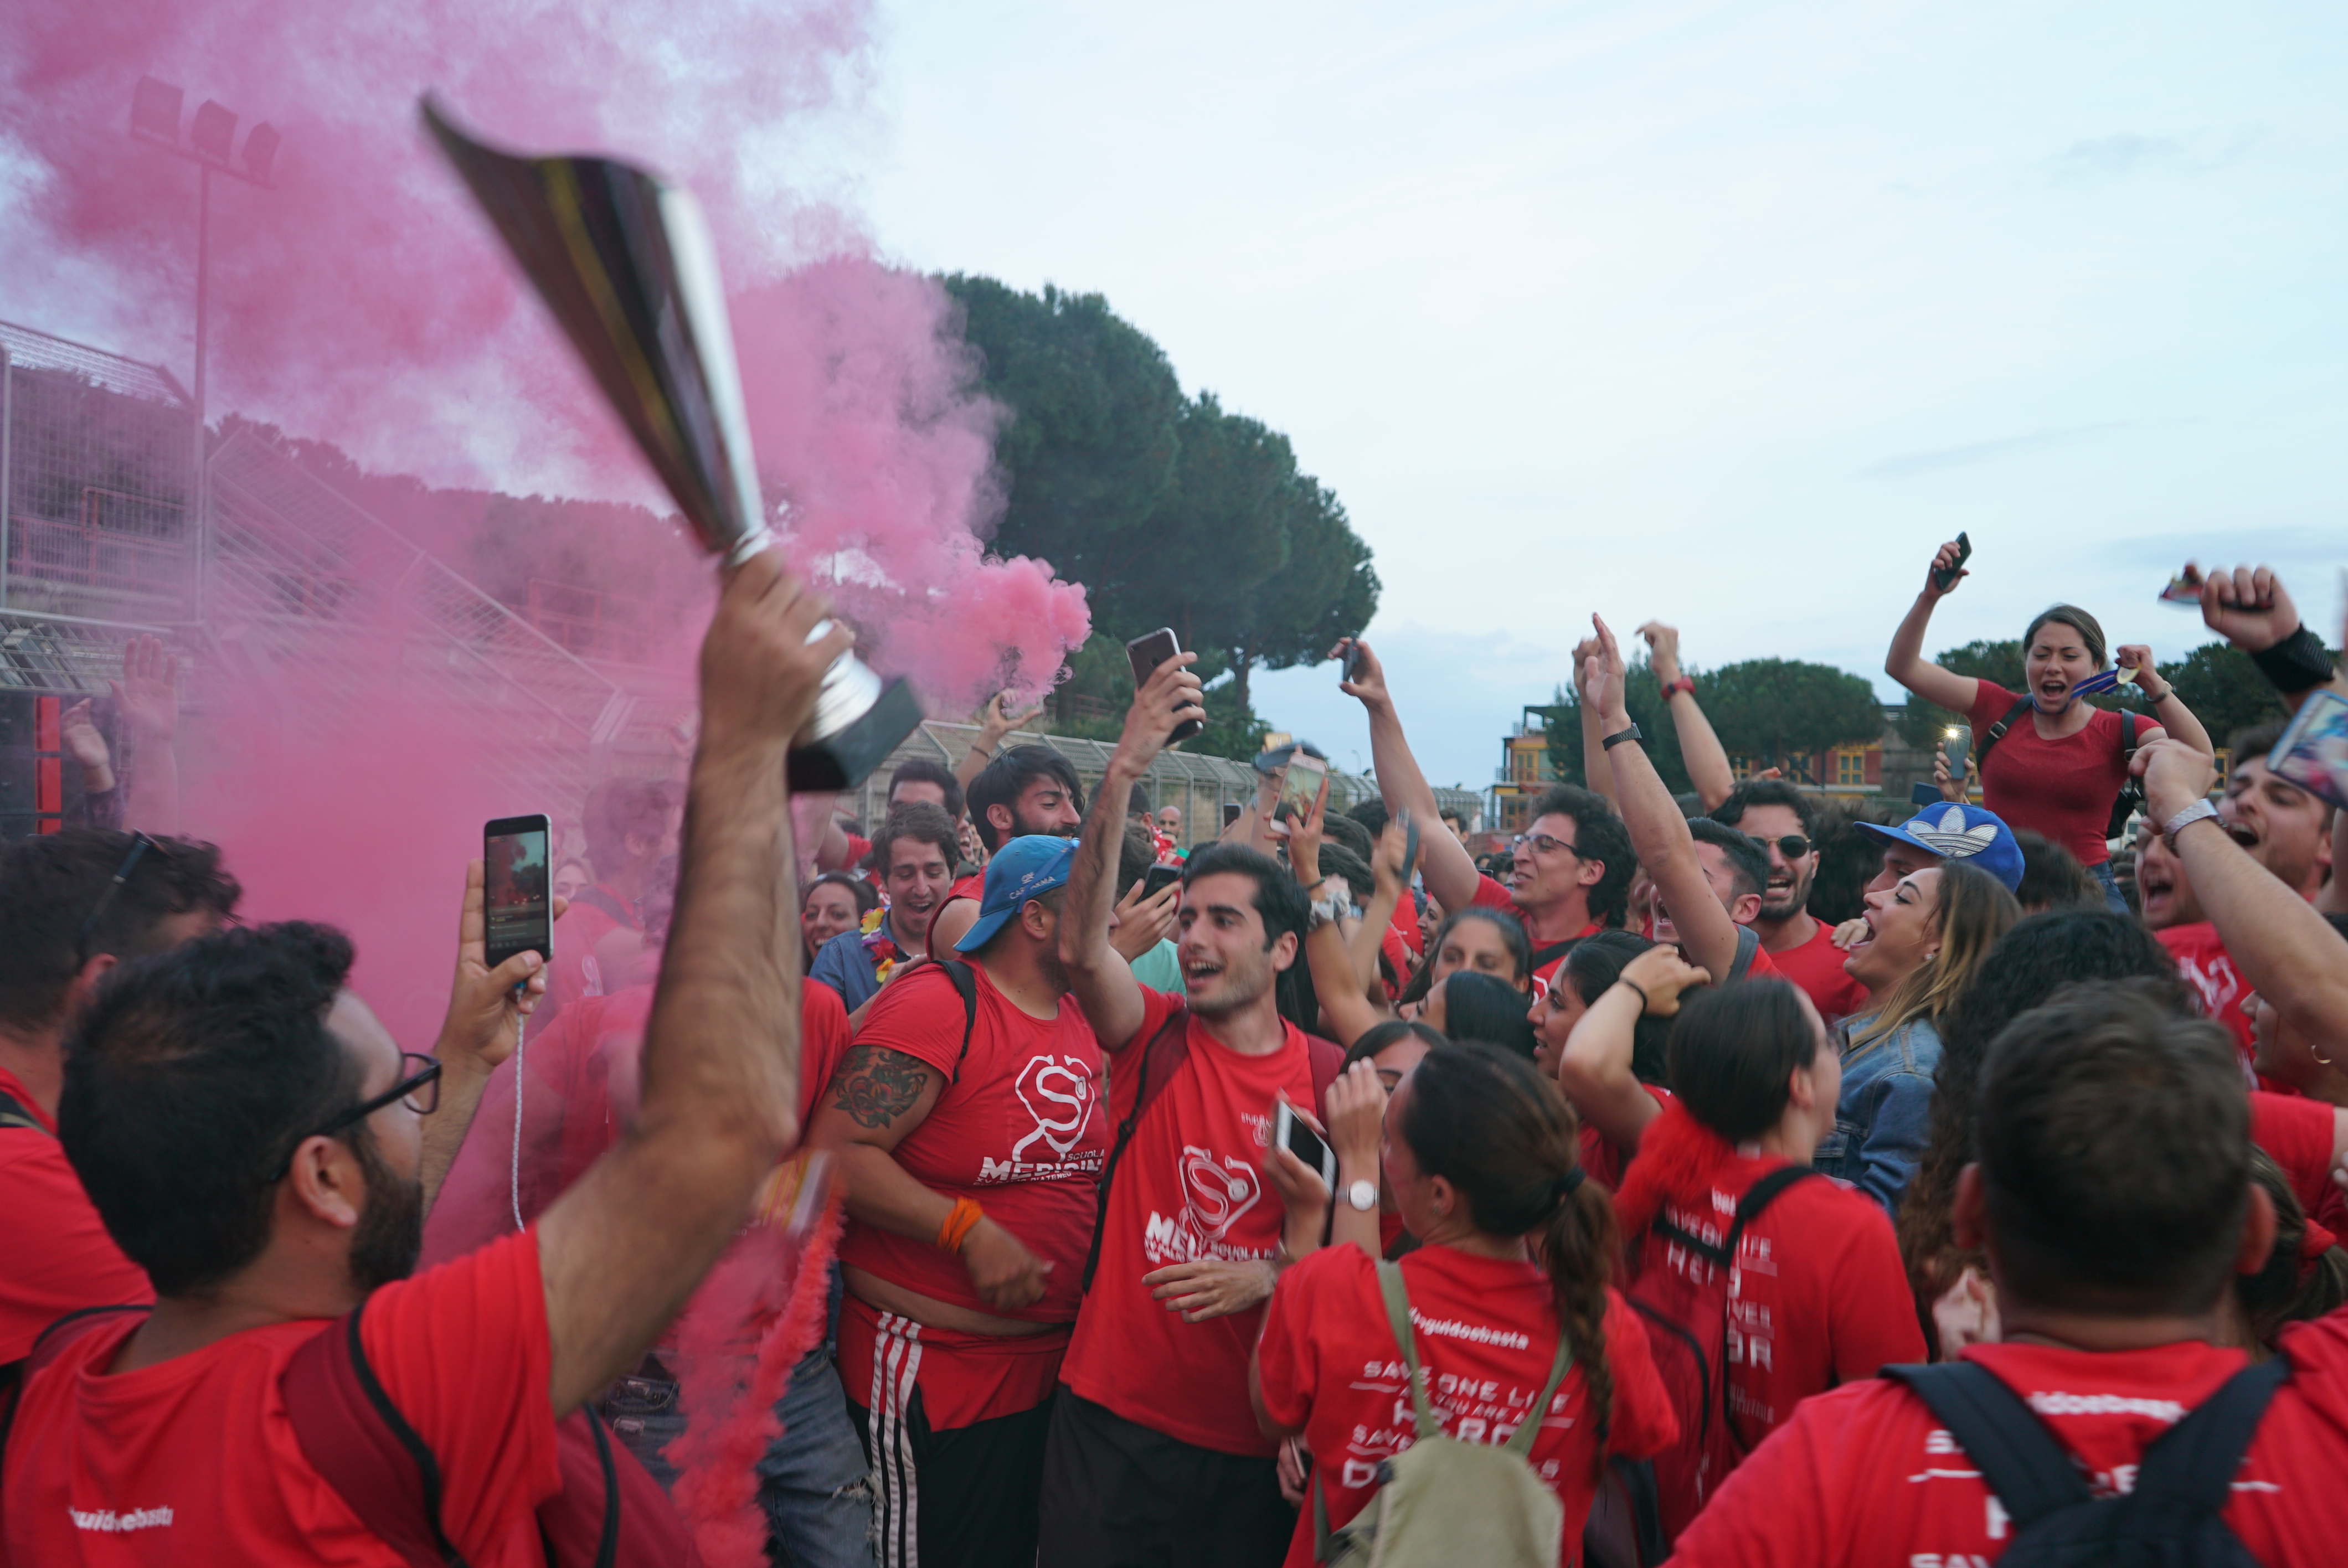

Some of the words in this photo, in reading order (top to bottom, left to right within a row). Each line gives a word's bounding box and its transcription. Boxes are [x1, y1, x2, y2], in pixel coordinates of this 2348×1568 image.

[1067, 1148, 1105, 1162] SCUOLA
[1363, 1360, 1433, 1386] SAVE
[1438, 1373, 1499, 1402] ONE
[1507, 1386, 1571, 1414] LIE
